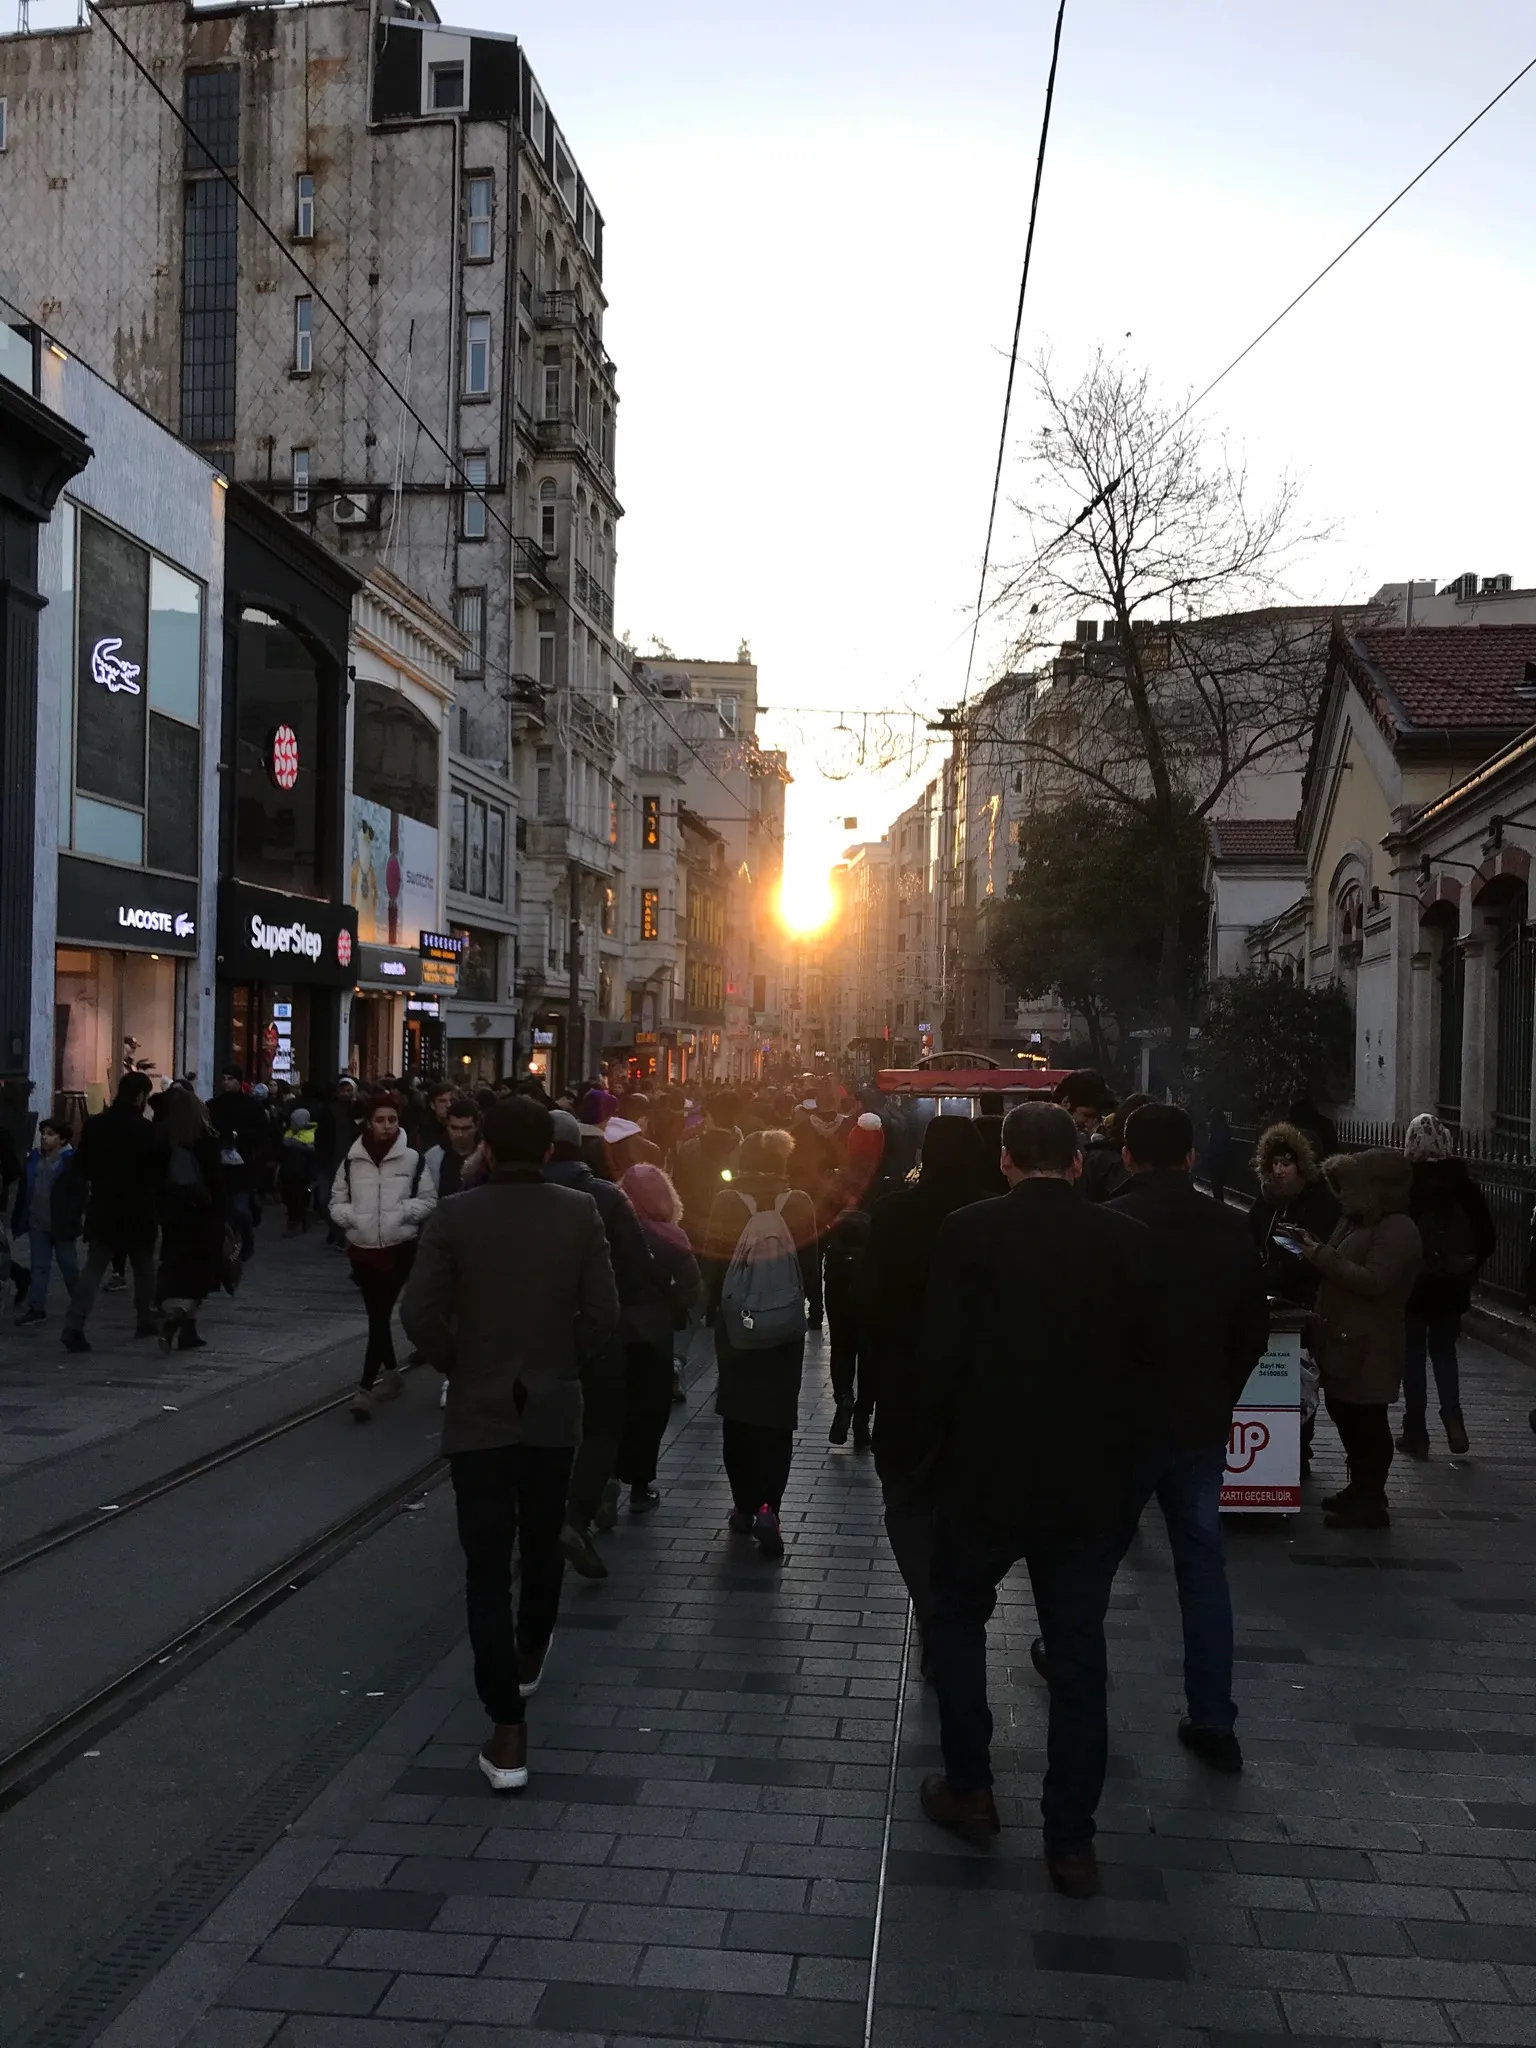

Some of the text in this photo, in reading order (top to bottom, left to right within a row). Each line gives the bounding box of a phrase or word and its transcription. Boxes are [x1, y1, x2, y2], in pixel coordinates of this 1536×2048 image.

[119, 906, 172, 934] LACOSTE
[250, 914, 323, 963] SuperStep
[1260, 1362, 1274, 1370] Bayi
[1220, 1490, 1243, 1501] KARTI
